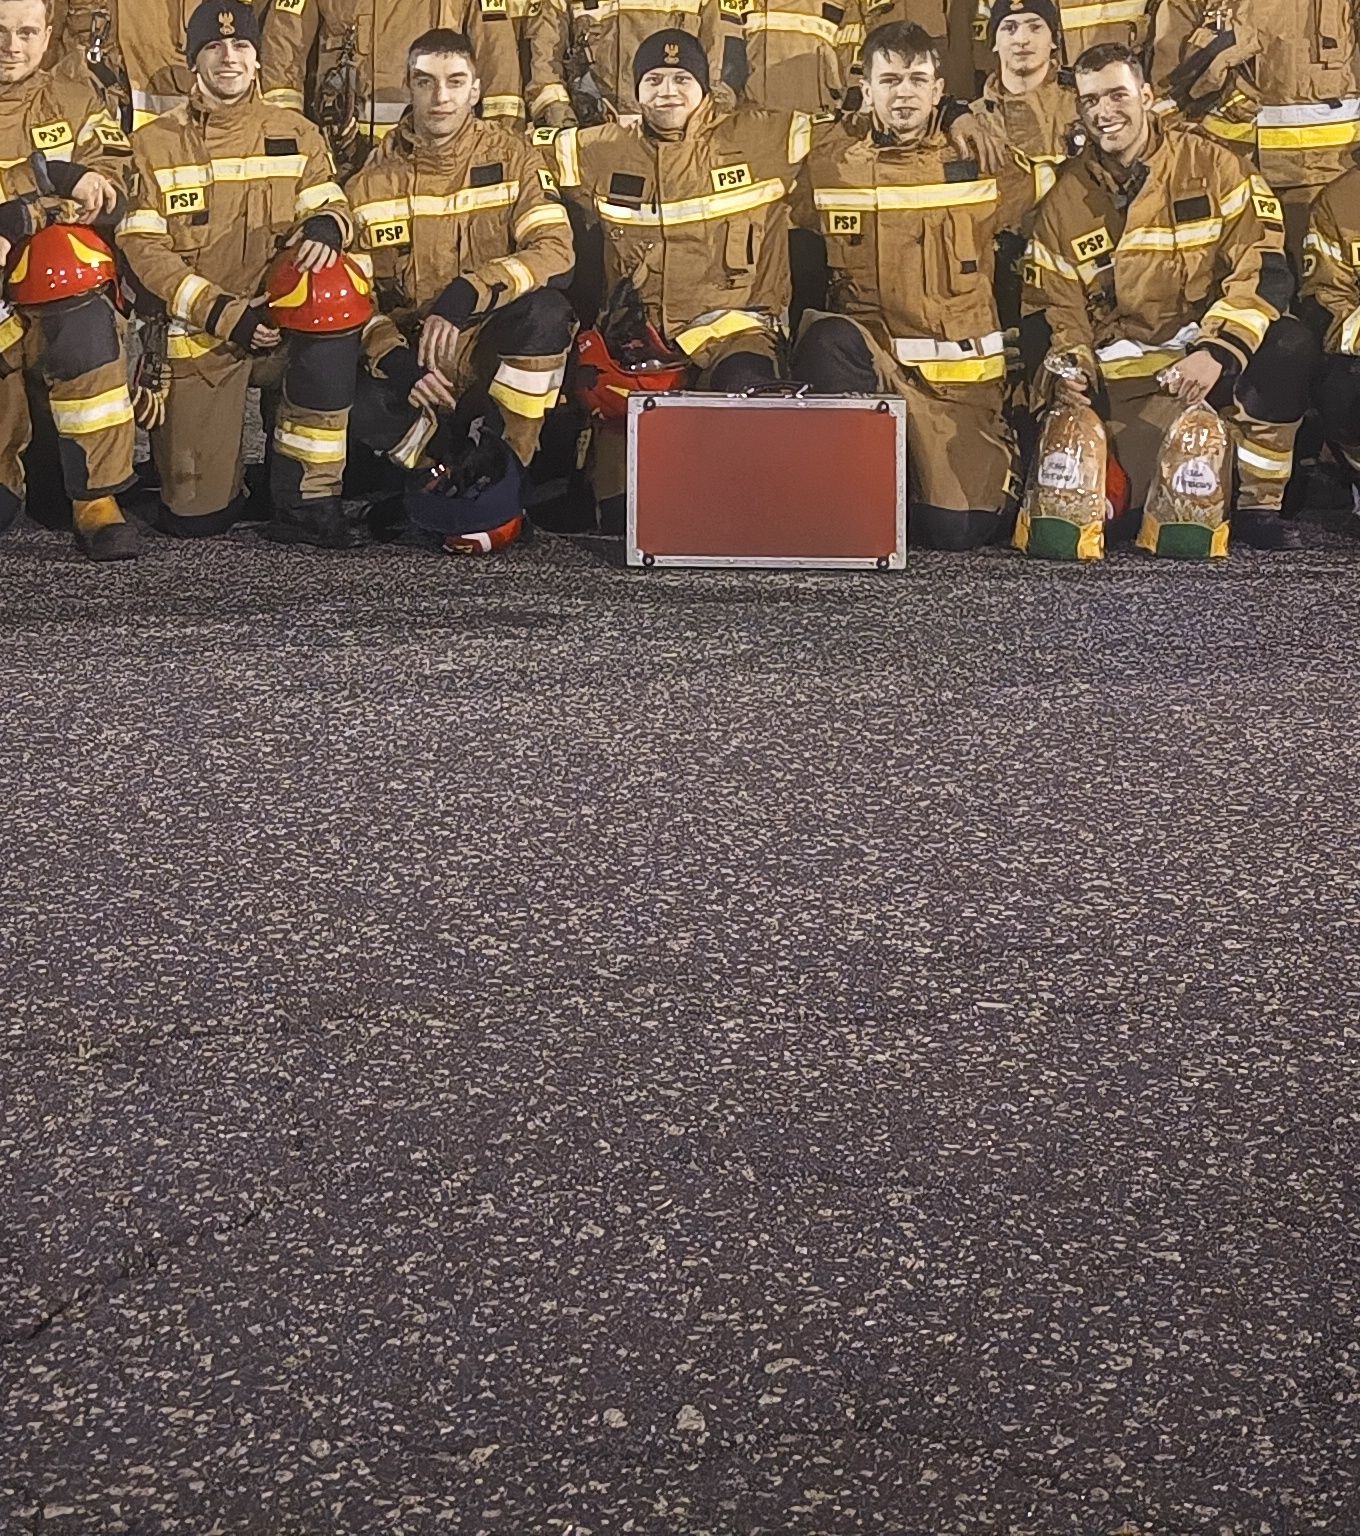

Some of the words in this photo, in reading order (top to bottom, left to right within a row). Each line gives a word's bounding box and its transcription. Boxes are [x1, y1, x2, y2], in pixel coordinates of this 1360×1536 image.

[37, 126, 65, 142] PSP
[718, 168, 745, 187] PSP
[170, 192, 198, 209] PSP
[834, 215, 858, 230] PSP
[376, 225, 403, 243] PSP
[1077, 234, 1105, 256] PSP
